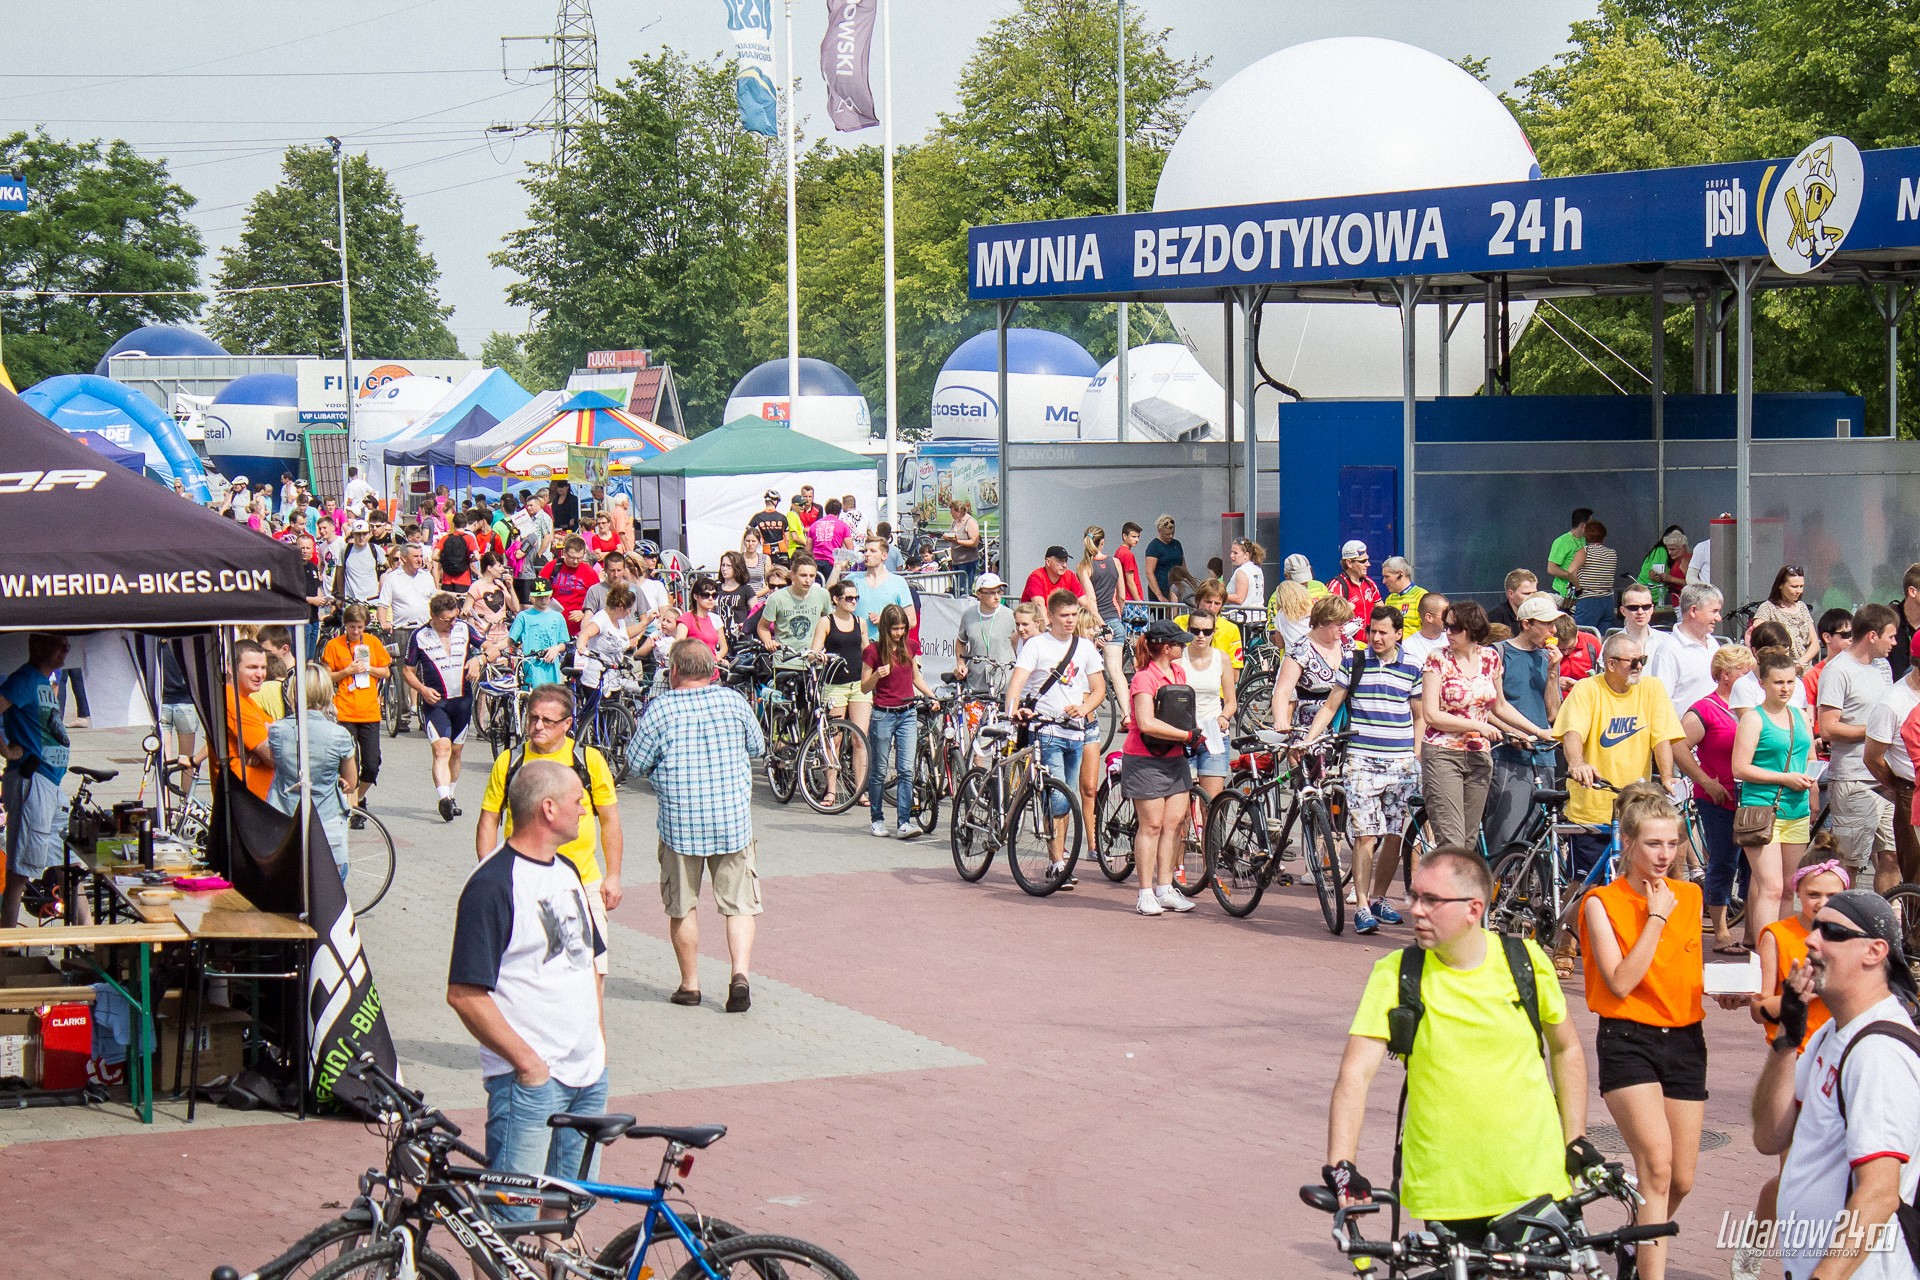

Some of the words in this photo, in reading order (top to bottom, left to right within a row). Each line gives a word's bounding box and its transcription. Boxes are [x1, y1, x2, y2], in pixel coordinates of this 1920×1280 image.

[1705, 179, 1729, 189] GRUPA
[1705, 178, 1747, 248] psb
[975, 233, 1104, 288] MYJNIA
[1133, 206, 1448, 278] BEZDOTYKOWA
[921, 637, 940, 656] Bank
[1607, 716, 1638, 733] NIKE
[52, 1017, 87, 1027] CLARKS
[479, 1174, 533, 1187] EVOLUTION
